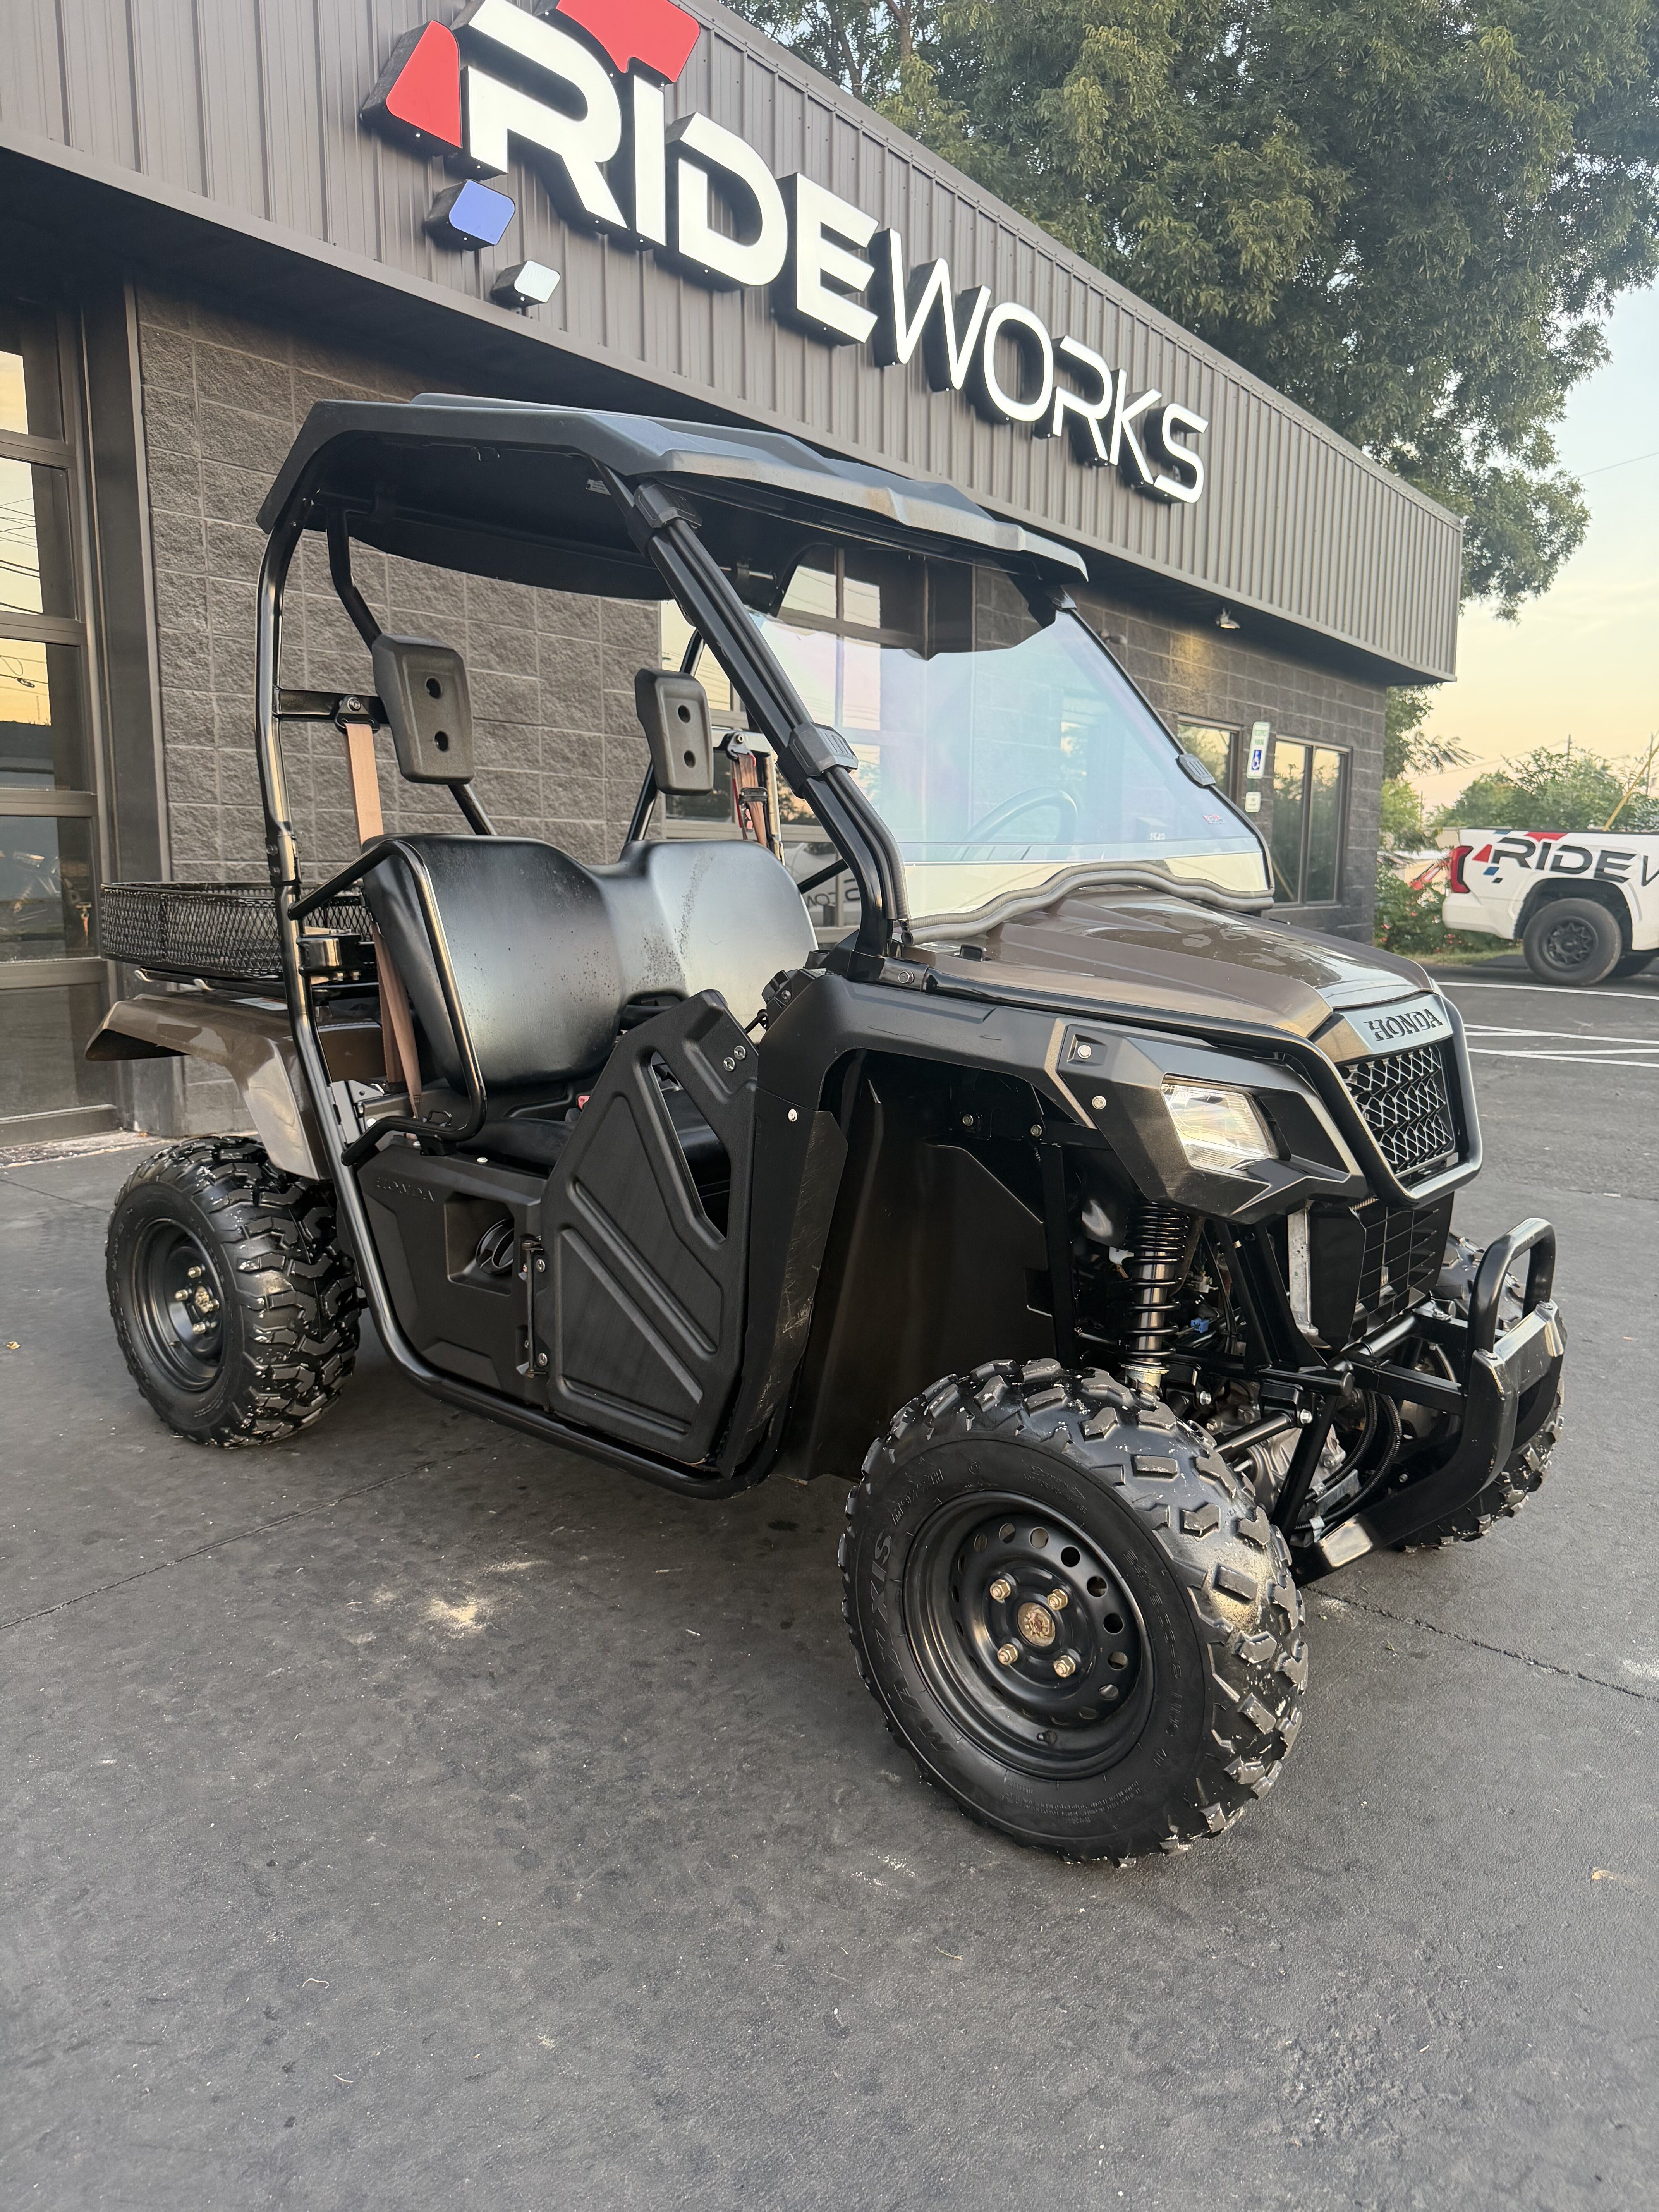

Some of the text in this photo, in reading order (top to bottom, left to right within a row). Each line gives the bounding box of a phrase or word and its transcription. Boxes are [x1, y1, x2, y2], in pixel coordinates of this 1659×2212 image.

[465, 0, 1209, 504] RIDEWORKS
[1364, 1008, 1443, 1041] HONDA
[376, 1177, 435, 1202] HONDA
